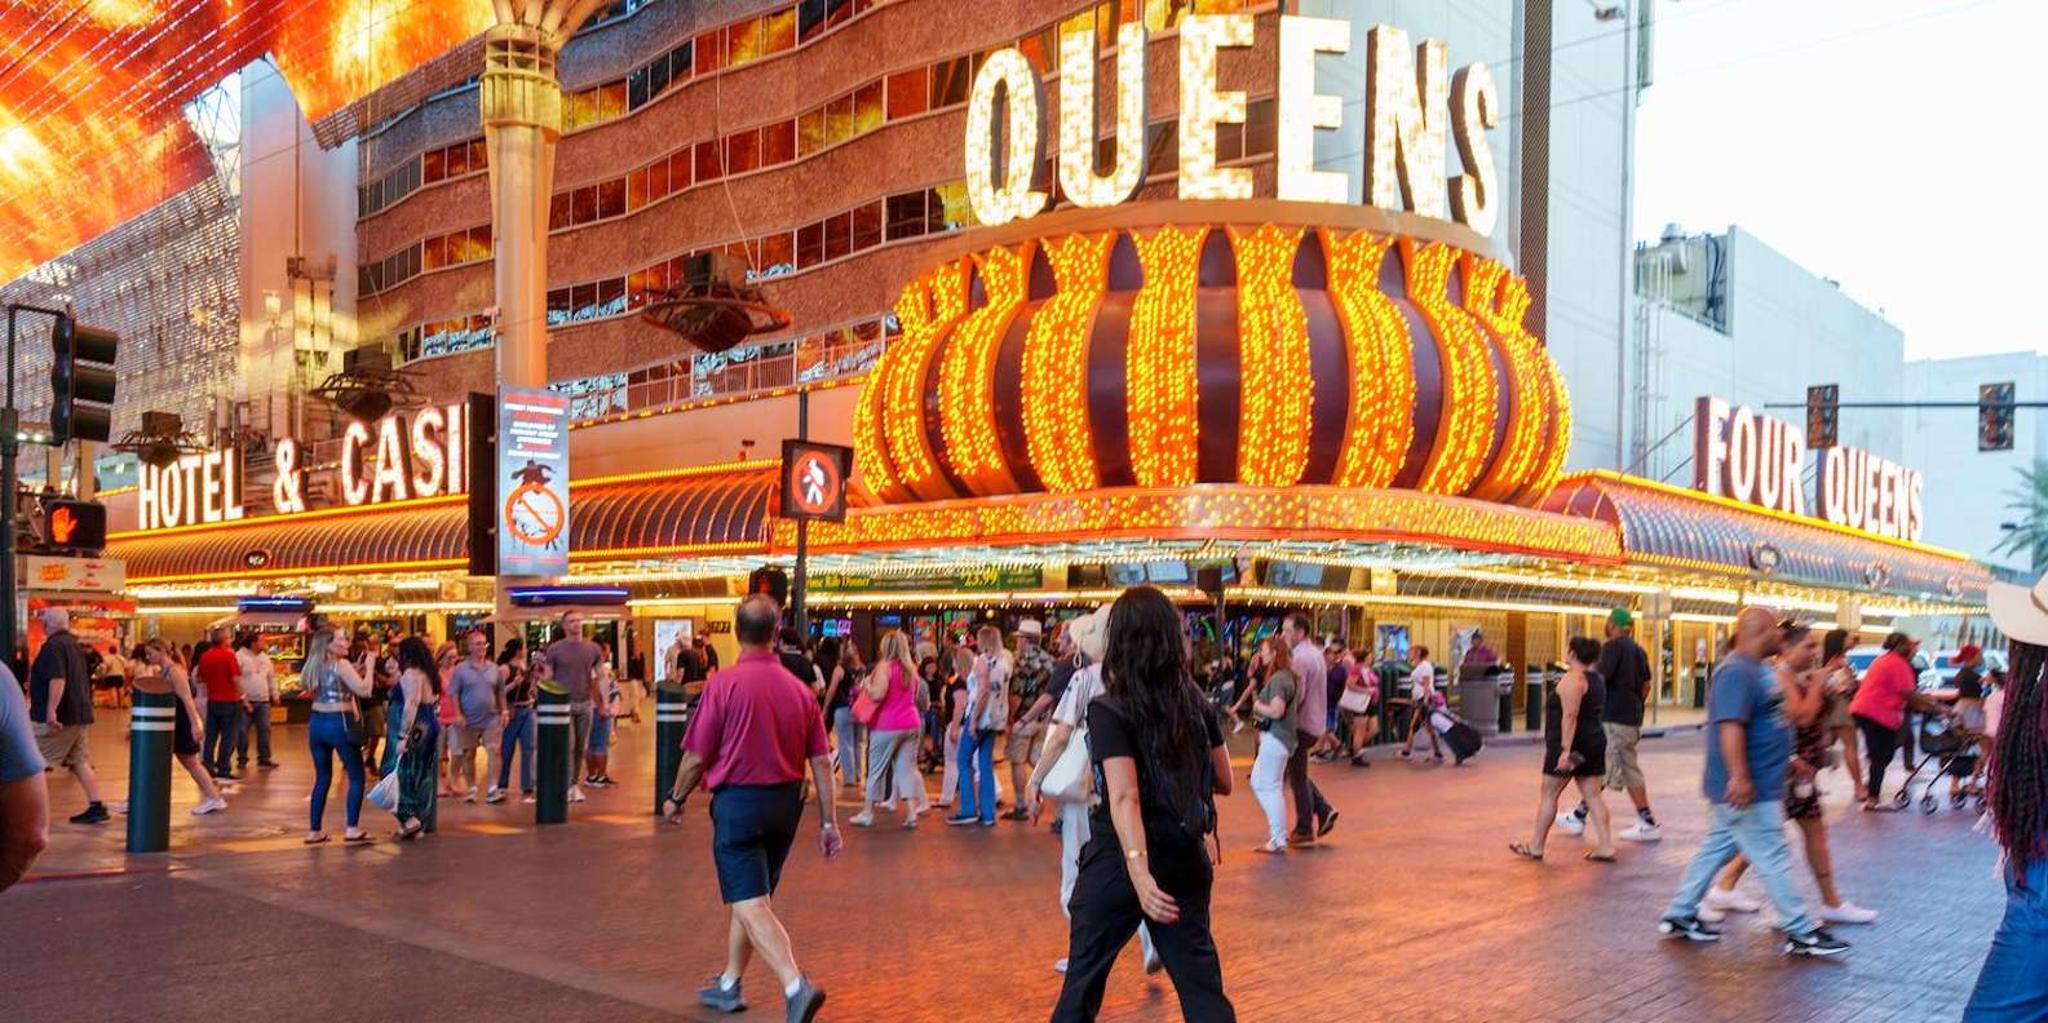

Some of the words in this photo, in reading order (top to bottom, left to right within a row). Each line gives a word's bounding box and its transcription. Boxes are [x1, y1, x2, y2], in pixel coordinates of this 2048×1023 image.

[964, 13, 1499, 238] QUEENS
[137, 447, 245, 530] HOTEL
[272, 436, 305, 515] &
[340, 402, 469, 506] CASI
[1705, 392, 1806, 517] FOUR
[1824, 444, 1924, 544] QUEENS
